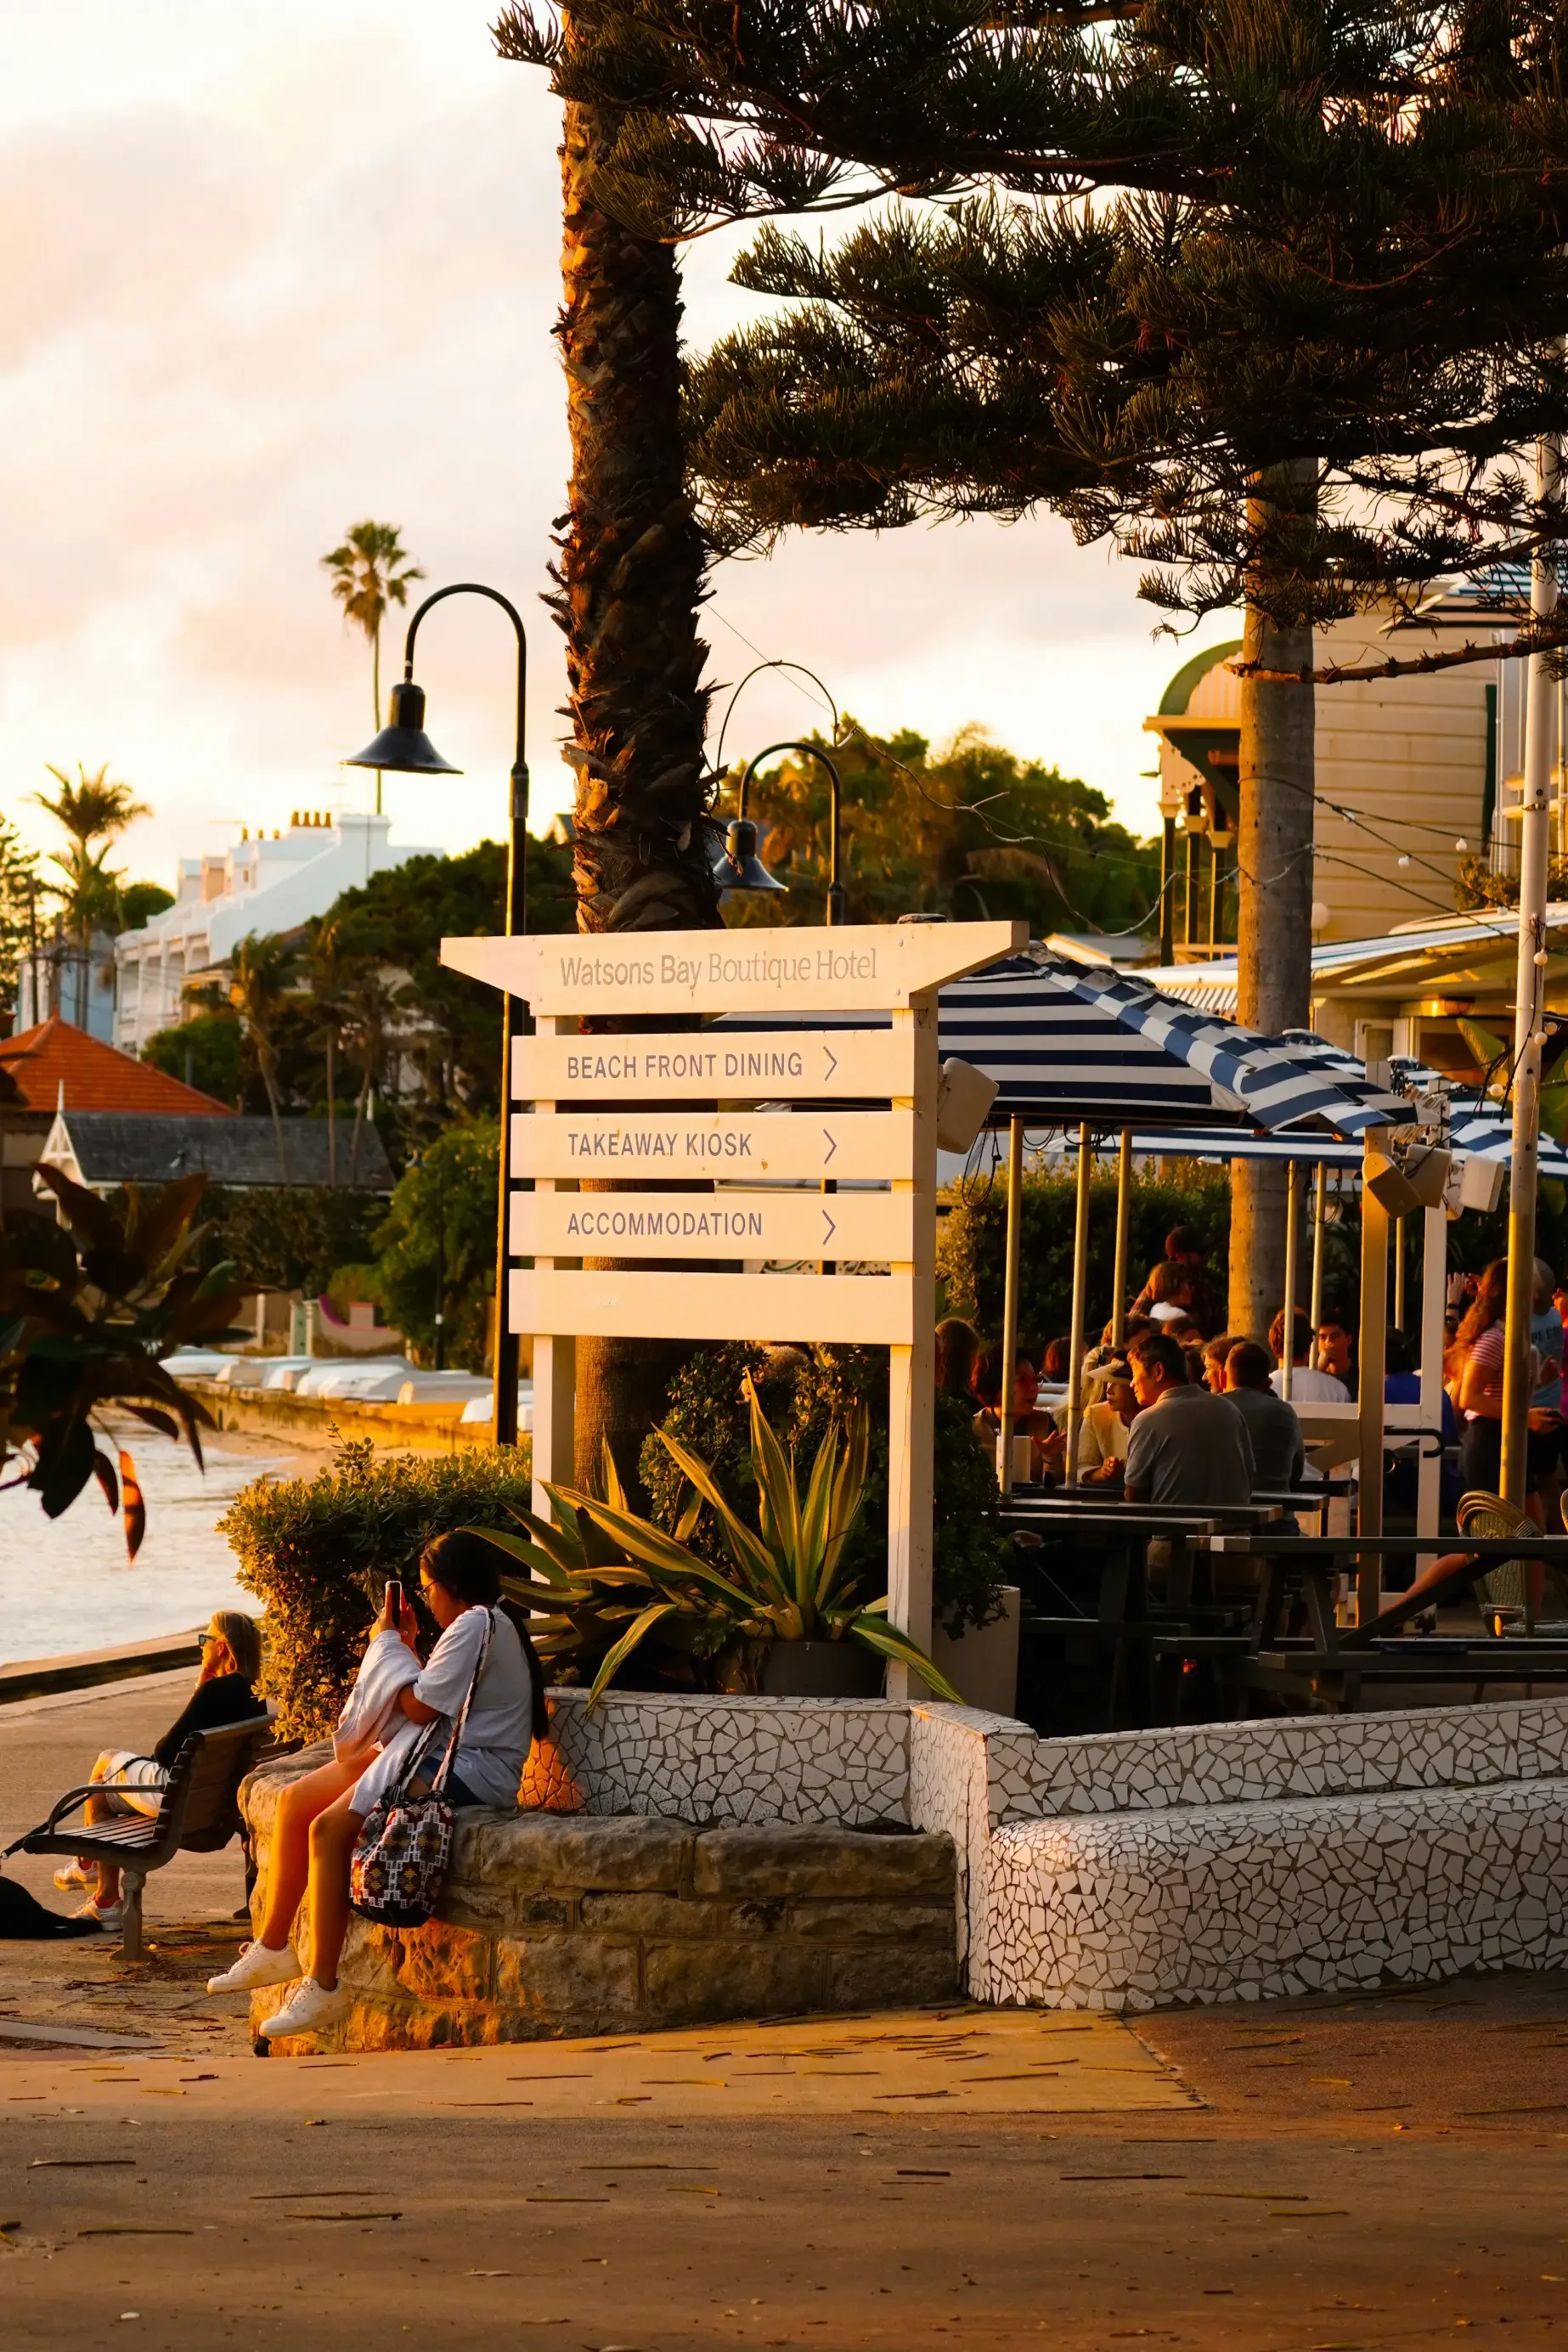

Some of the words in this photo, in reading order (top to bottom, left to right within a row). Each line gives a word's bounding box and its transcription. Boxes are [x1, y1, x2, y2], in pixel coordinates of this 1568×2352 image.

[560, 956, 655, 987] Watsons
[661, 955, 702, 990] Bay
[708, 953, 811, 989] Boutique
[816, 948, 877, 980] Hotel
[567, 1055, 636, 1080] BEACH
[646, 1053, 717, 1078] FRONT
[725, 1052, 803, 1077] DINING
[567, 1132, 678, 1156] TAKEAWAY
[686, 1132, 753, 1157] KIOSK
[567, 1211, 762, 1236] ACCOMMODATION
